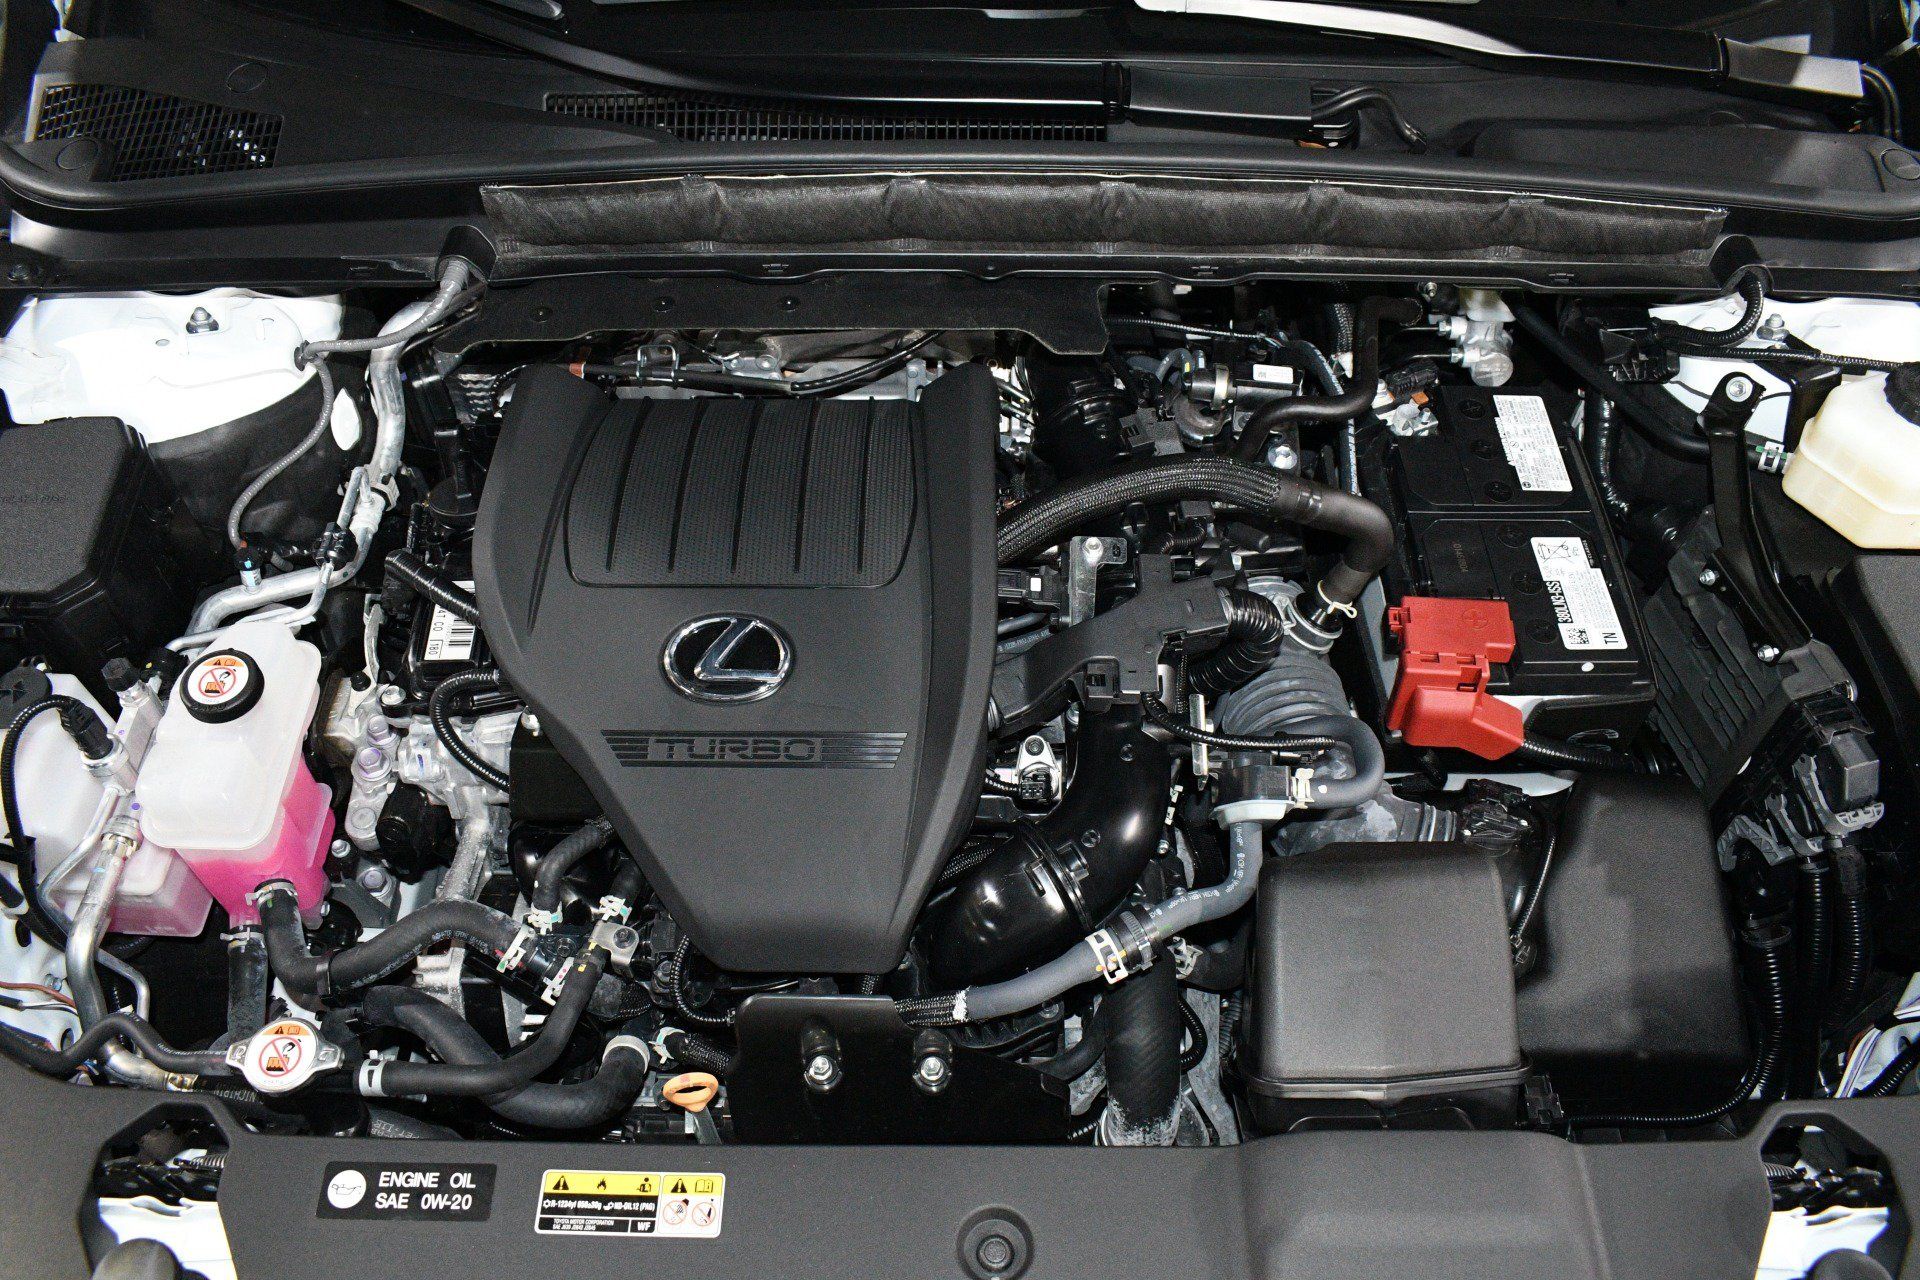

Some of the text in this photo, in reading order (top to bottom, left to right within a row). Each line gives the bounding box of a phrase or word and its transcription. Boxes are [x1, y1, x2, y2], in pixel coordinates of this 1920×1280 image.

[655, 738, 815, 761] TURBO
[379, 1171, 476, 1189] ENGINE OIL
[375, 1193, 472, 1211] SAE 0W-20
